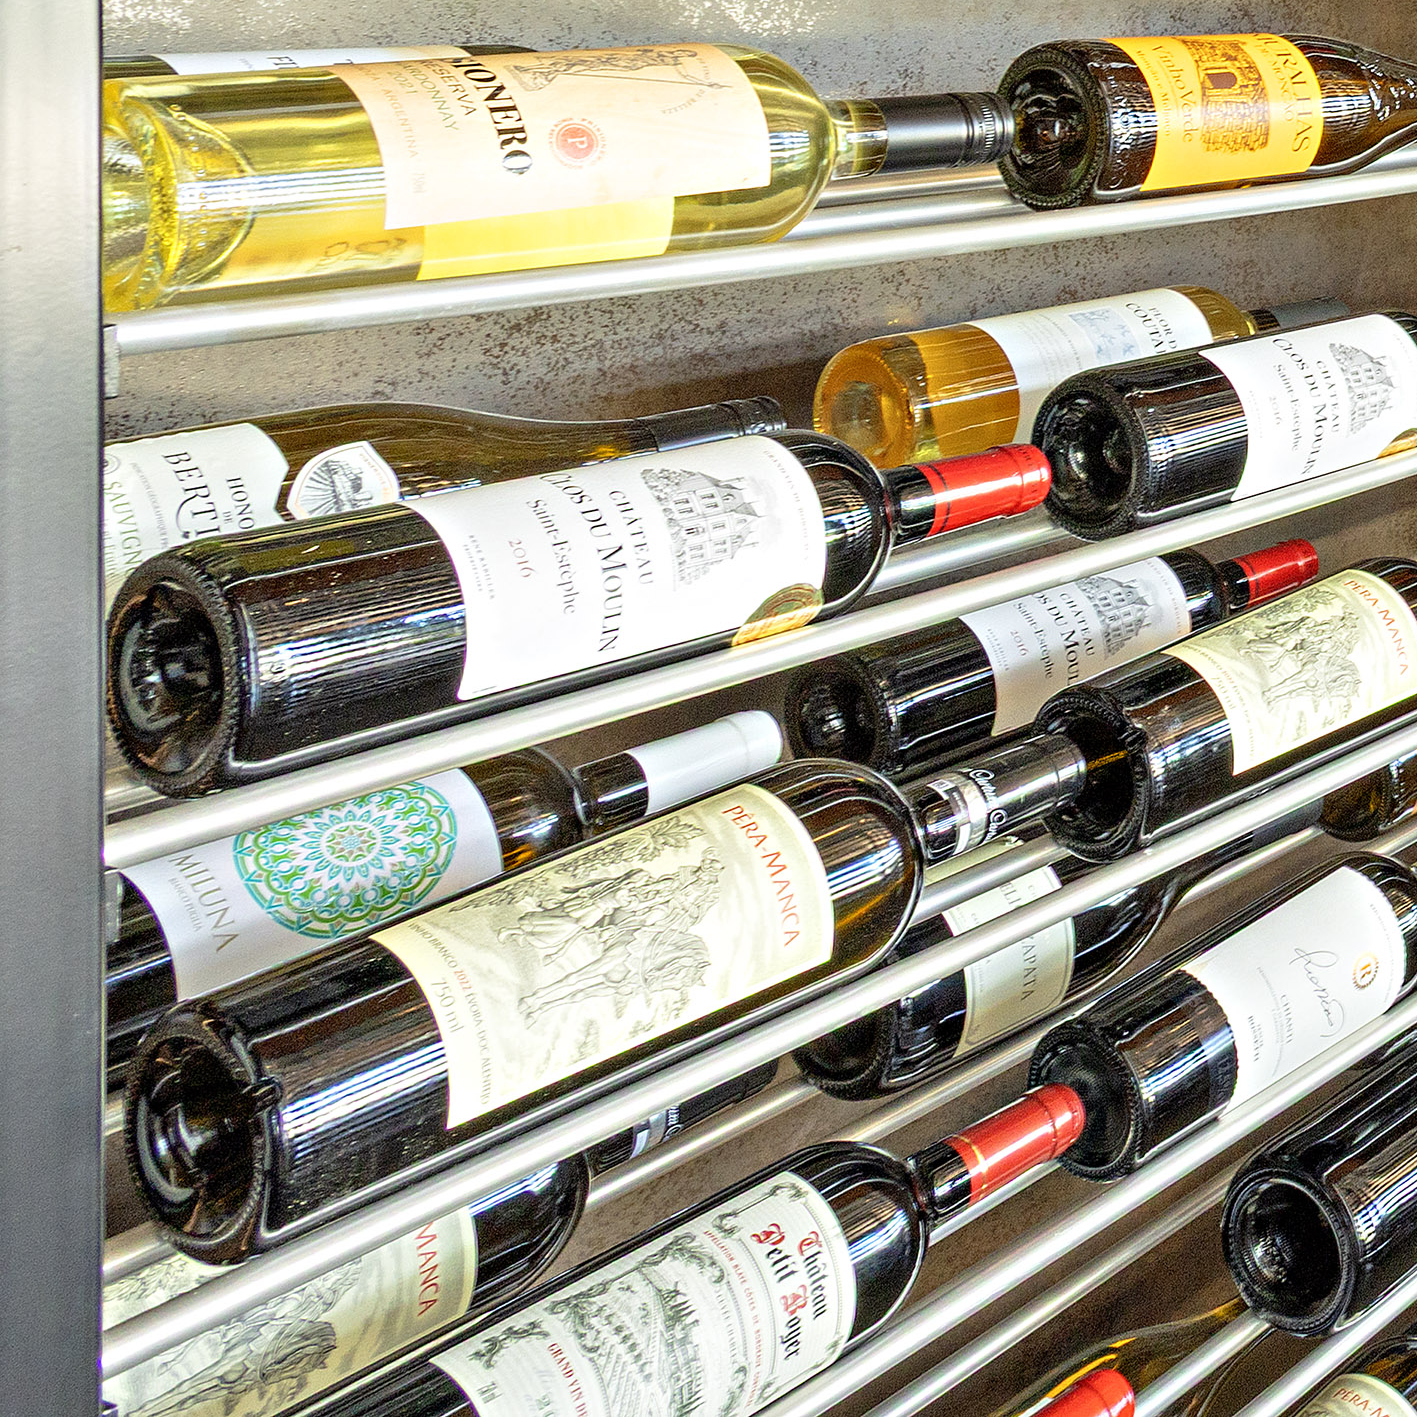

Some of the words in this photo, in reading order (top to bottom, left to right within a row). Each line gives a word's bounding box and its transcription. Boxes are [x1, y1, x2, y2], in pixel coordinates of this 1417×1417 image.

[399, 62, 460, 131] ARDONNAY
[450, 56, 533, 176] SIONERO
[1152, 45, 1186, 94] Vinho
[1180, 91, 1199, 143] Verde
[1270, 59, 1295, 122] MONÇÃO
[1125, 302, 1166, 355] COUTA
[1272, 338, 1307, 372] CLOS
[1273, 363, 1303, 452] Saint-Estèphe
[1304, 372, 1321, 399] DU
[1316, 360, 1341, 434] CHÂTEAU
[1301, 403, 1328, 475] MOULIN
[103, 480, 144, 567] SAUVIGN
[161, 450, 221, 537] BERTI
[222, 510, 234, 524] DE
[226, 476, 255, 530] HONO
[508, 537, 537, 580] 2016
[527, 498, 580, 616] Saint-Estèphe
[539, 472, 594, 507] CLOS
[579, 506, 611, 538] DU
[596, 545, 628, 653] MOULIN
[609, 490, 655, 585] CHÂTEAU
[1010, 630, 1030, 657] 2016
[1013, 601, 1055, 679] Saint-Estèphe
[1046, 605, 1068, 627] DU
[1060, 629, 1080, 686] MOUL
[1059, 592, 1095, 658] CHÂTEAU
[1343, 579, 1410, 675] PÊRA-MANCA
[169, 853, 240, 953] MILUNA
[721, 805, 802, 948] PÊRA-MANCA
[430, 938, 458, 969] BRANCO
[453, 968, 473, 992] 2022
[431, 977, 458, 1008] 750
[441, 1007, 465, 1035] ml
[1280, 994, 1293, 1045] CHIANTI
[414, 1221, 441, 1317] MANCA
[703, 1229, 737, 1267] APPELLATION
[732, 1266, 749, 1289] BLAYE
[742, 1289, 757, 1314] CÔTES
[752, 1327, 764, 1368] BORDEAUX
[748, 1222, 801, 1284] Petit
[781, 1284, 809, 1362] Boyer
[797, 1230, 829, 1322] Château
[547, 1342, 574, 1379] GRAND
[569, 1378, 584, 1398] VIN
[1332, 1386, 1389, 1417] PÊRA-M
